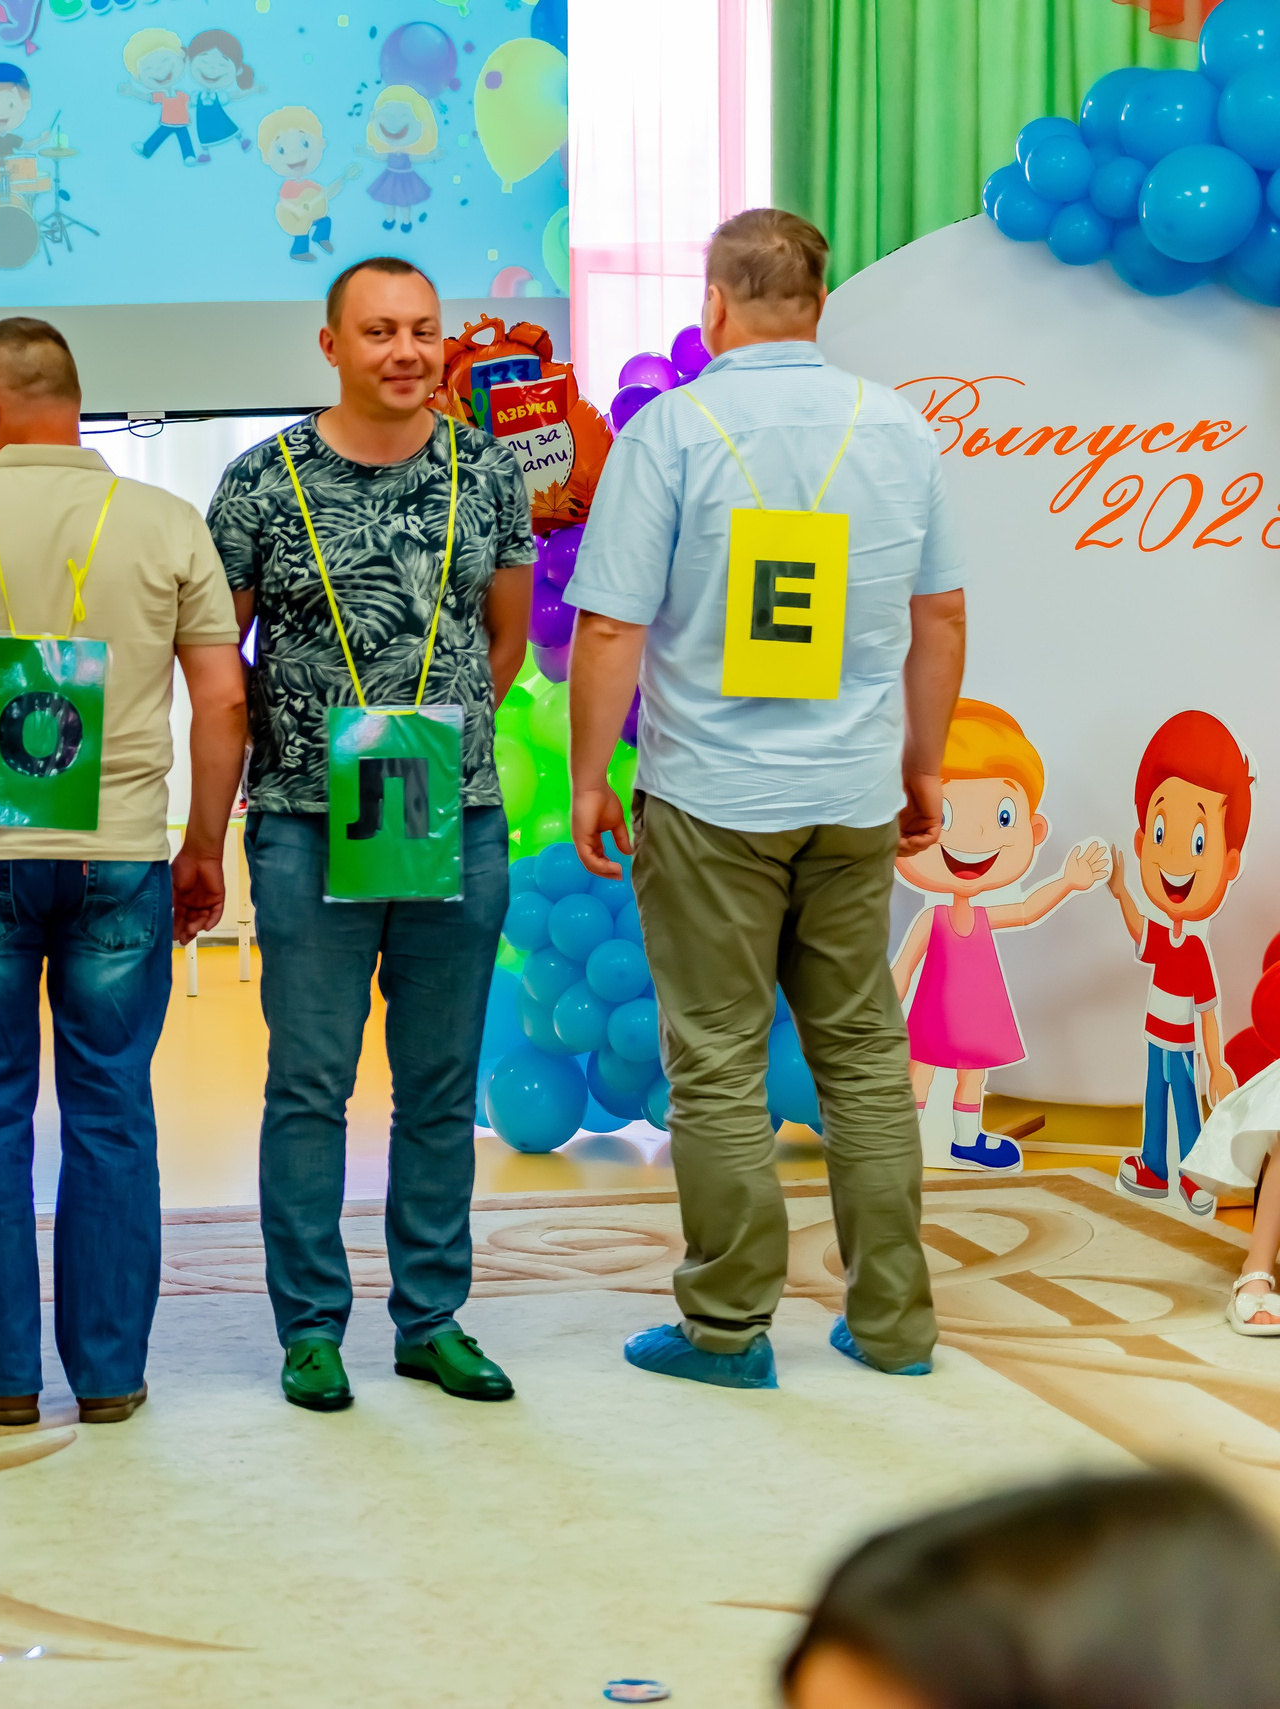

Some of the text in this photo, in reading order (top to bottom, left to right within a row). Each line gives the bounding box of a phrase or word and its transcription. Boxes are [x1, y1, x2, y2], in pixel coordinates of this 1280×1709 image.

[477, 360, 530, 389] 123
[496, 400, 558, 424] АЗБУКА
[535, 428, 562, 446] за
[894, 375, 1249, 514] Выпуск
[522, 449, 568, 473] ами
[750, 559, 816, 644] Е
[346, 757, 430, 840] Л
